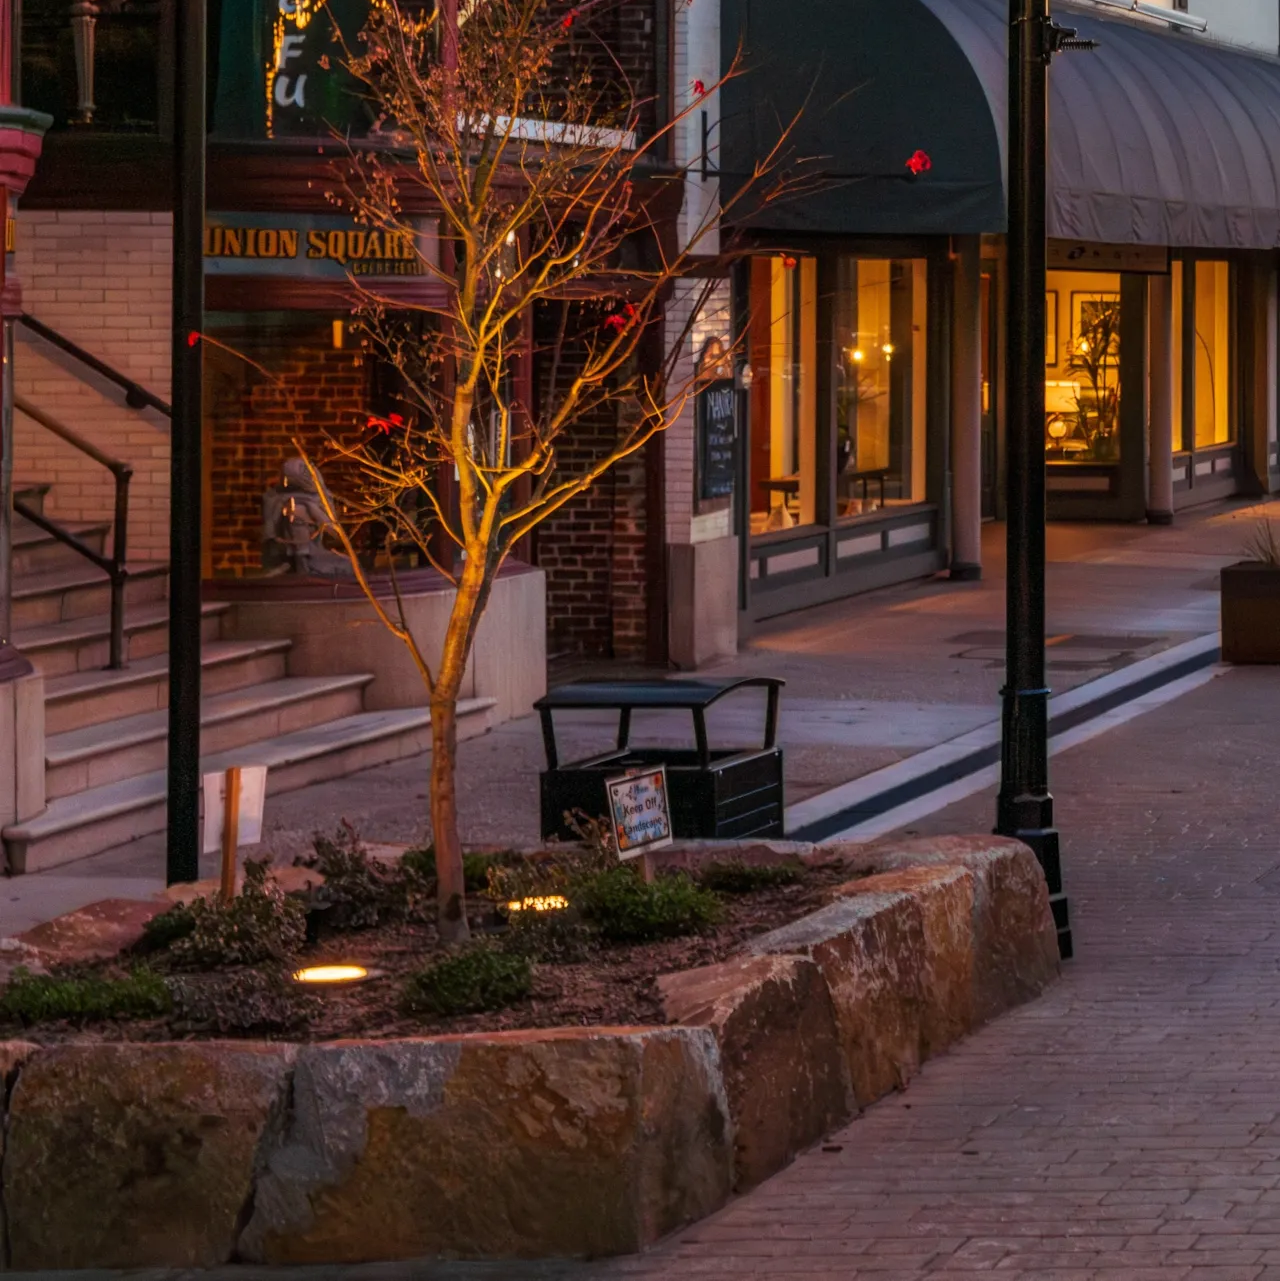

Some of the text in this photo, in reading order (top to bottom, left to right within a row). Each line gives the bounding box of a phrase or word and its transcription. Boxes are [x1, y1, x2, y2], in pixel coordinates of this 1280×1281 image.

[275, 33, 307, 110] FU
[203, 228, 416, 264] UNION SQUARE
[623, 803, 643, 817] Keep
